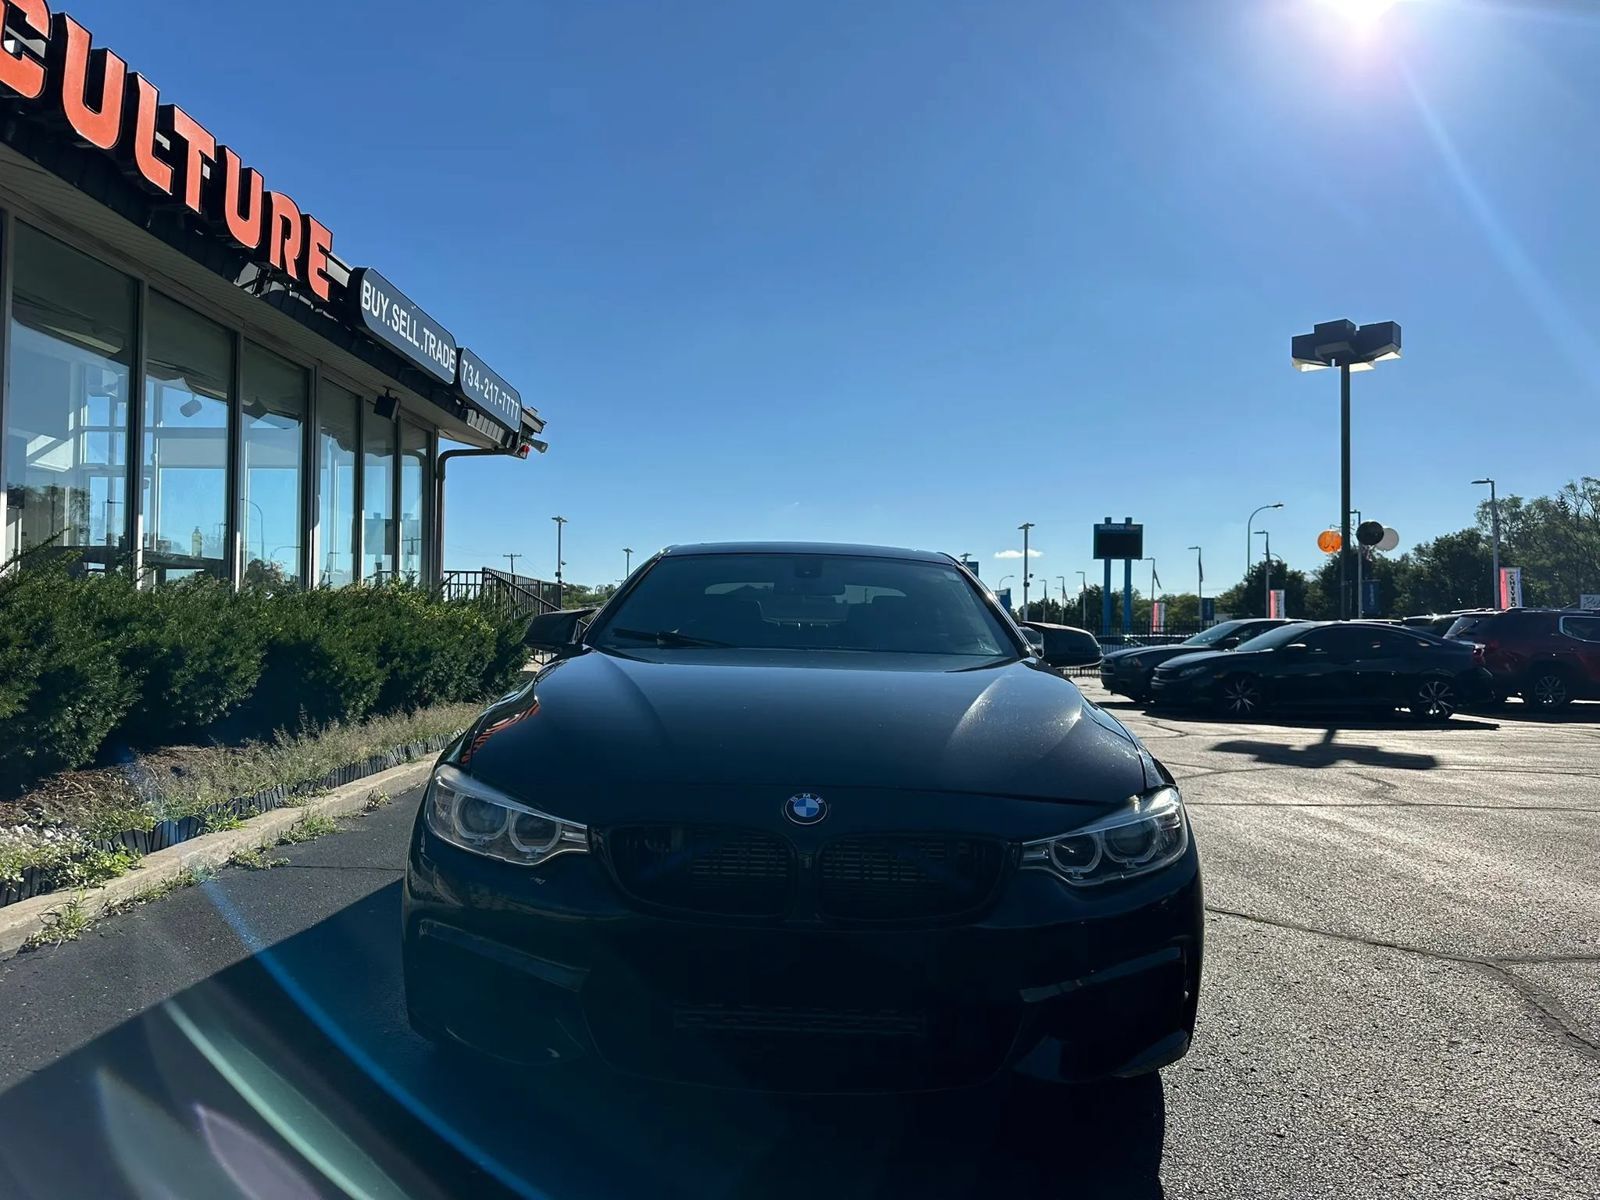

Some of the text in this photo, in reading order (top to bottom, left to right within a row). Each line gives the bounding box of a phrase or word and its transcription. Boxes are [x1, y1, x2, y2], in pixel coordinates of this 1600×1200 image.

[0, 0, 333, 302] CULTURE
[361, 279, 457, 374] BUY.SELL.TRADE
[462, 359, 520, 421] 734-217-7777
[790, 792, 823, 804] BMW
